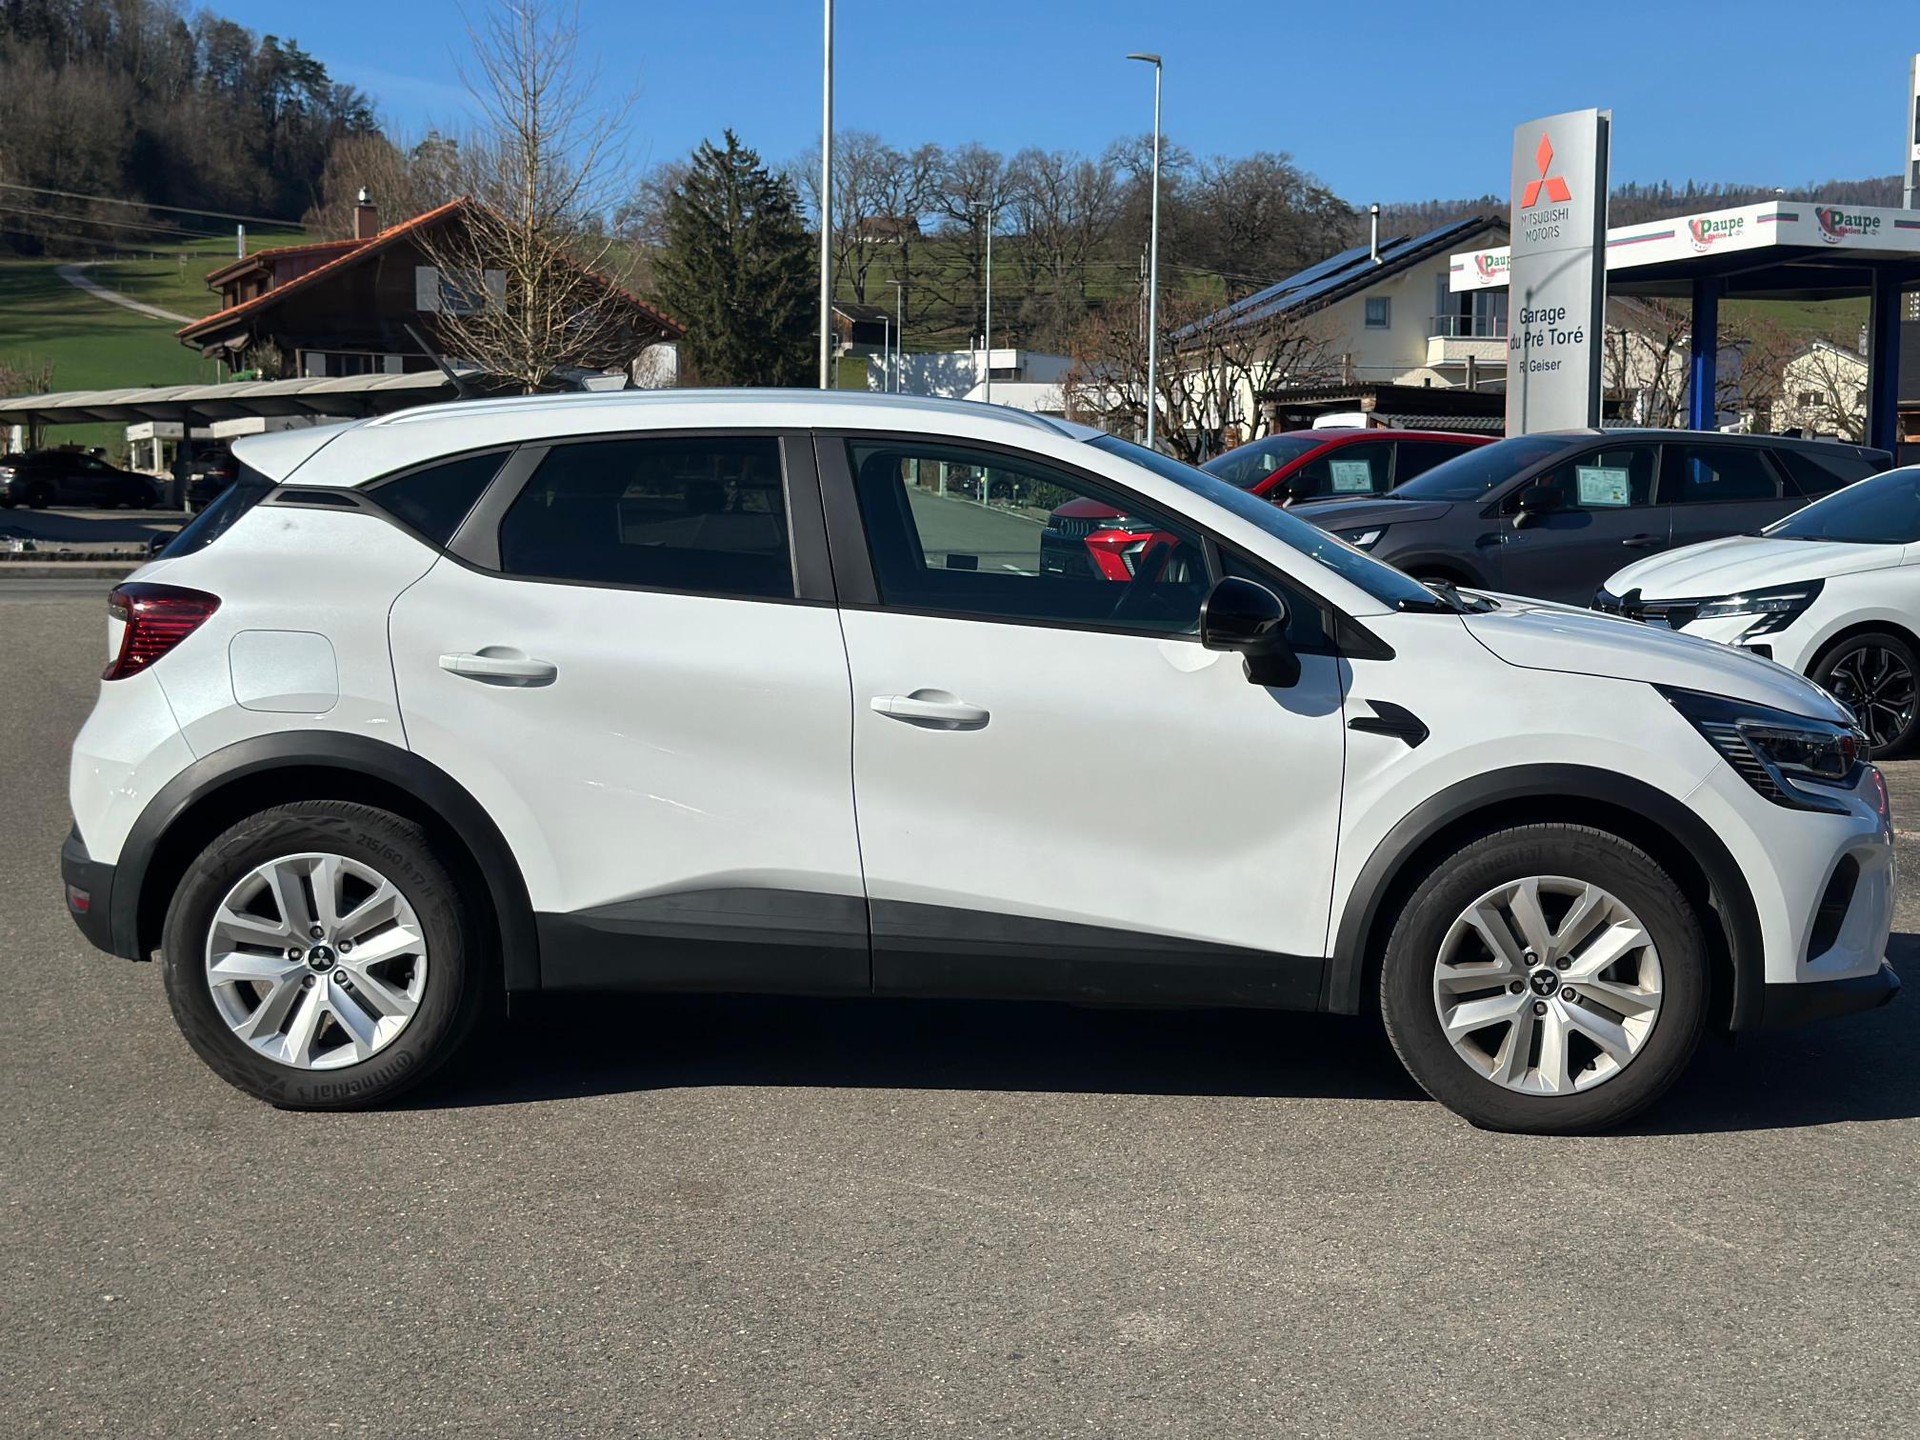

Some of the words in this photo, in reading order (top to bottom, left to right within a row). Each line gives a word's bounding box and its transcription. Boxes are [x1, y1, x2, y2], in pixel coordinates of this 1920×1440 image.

[1521, 207, 1569, 226] MITSUBISHI
[1830, 211, 1880, 235] Paupe
[1526, 226, 1560, 243] MOTORS
[1700, 217, 1744, 241] Paupe
[1519, 307, 1566, 325] Garage
[1510, 333, 1521, 350] du
[1524, 329, 1544, 348] Pré
[1549, 326, 1584, 346] Toré
[1529, 359, 1562, 373] Geiser
[356, 833, 403, 865] 215/60
[312, 1050, 415, 1101] Continental
